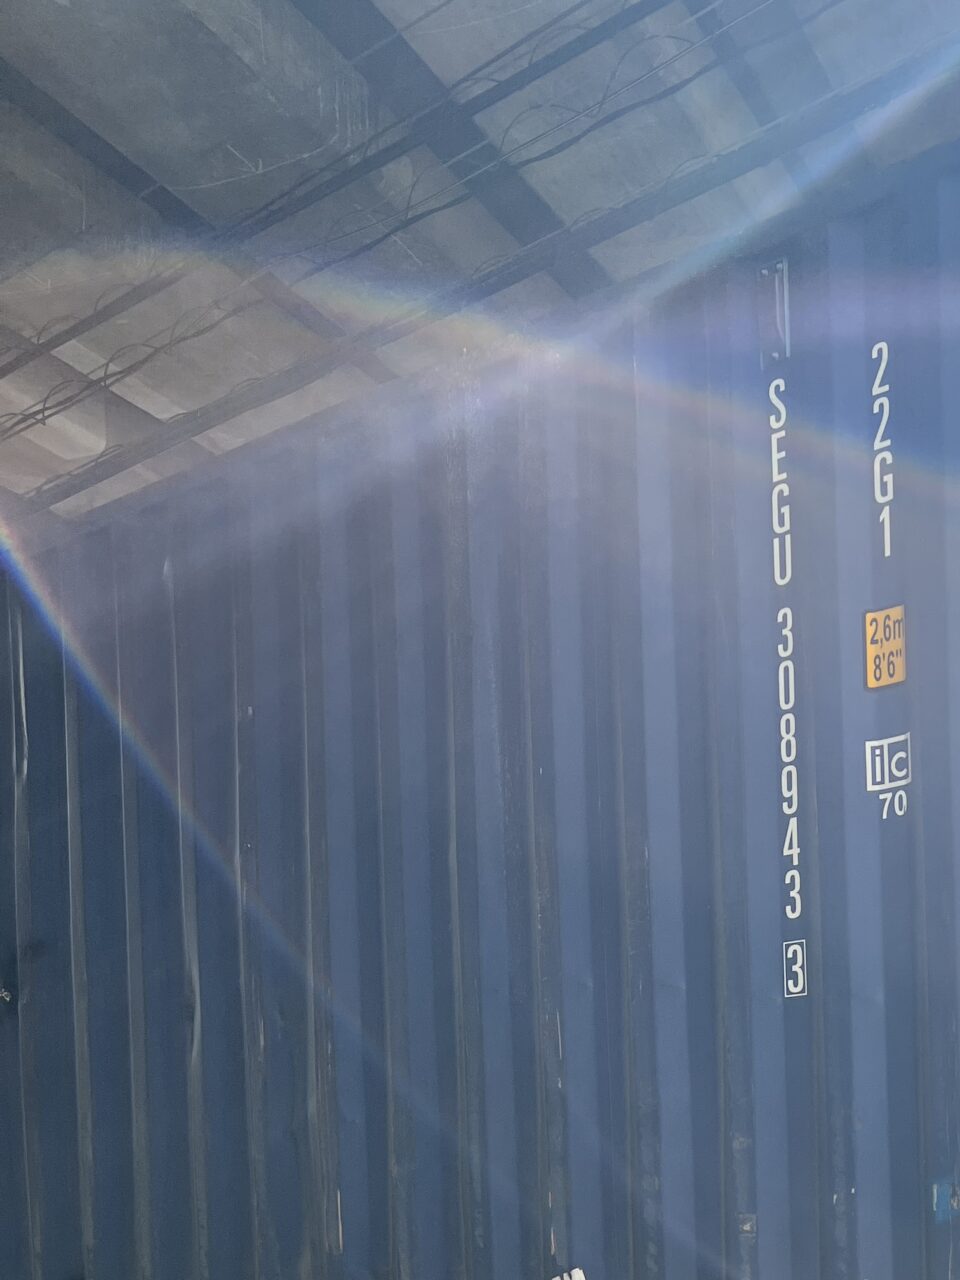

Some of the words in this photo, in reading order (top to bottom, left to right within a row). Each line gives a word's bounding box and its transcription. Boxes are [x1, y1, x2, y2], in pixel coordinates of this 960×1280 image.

[768, 377, 793, 586] SEGU
[871, 341, 894, 558] 22G1
[776, 607, 802, 919] 308943
[879, 789, 908, 820] 70
[786, 942, 805, 994] 3
